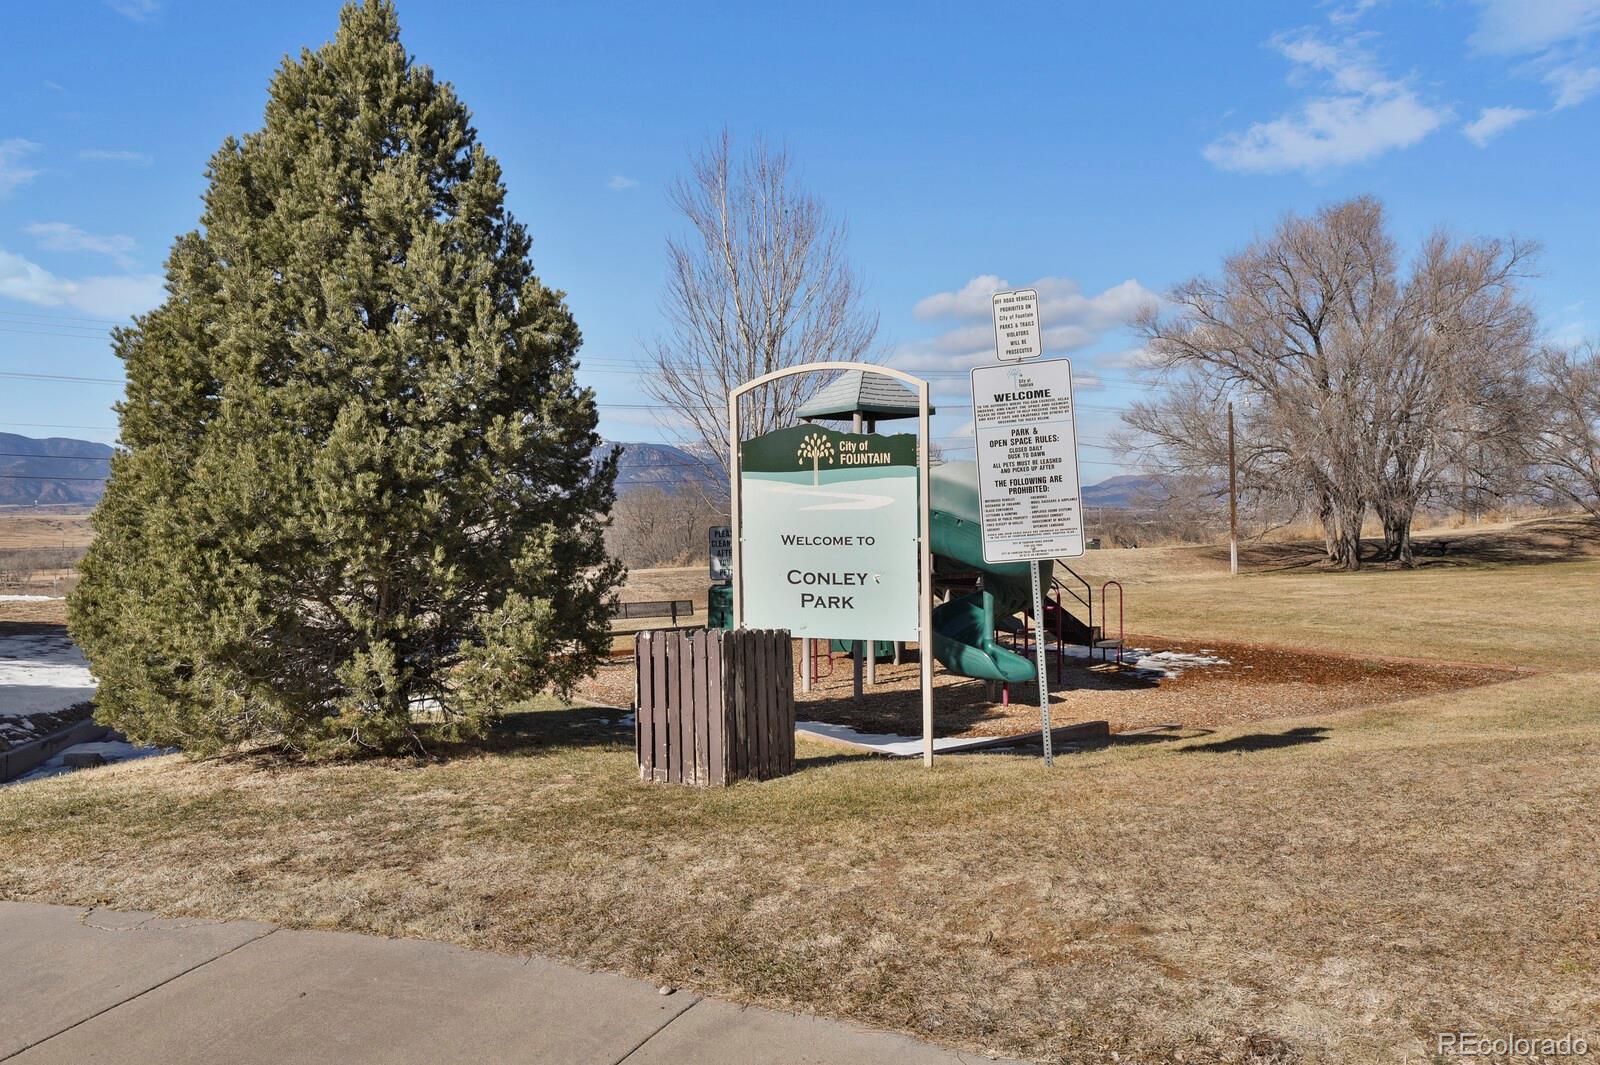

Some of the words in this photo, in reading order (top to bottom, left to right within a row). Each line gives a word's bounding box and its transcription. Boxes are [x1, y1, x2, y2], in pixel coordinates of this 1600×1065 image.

[994, 389, 1051, 402] WELCOME
[839, 440, 857, 453] City
[859, 440, 868, 451] of
[1010, 437, 1032, 446] SPACE
[1035, 434, 1059, 443] RULES:
[840, 452, 891, 465] FOUNTAIN
[1010, 476, 1046, 486] FOLLOWING
[1009, 485, 1049, 494] PROHIBITED:
[781, 535, 853, 546] WELCOME
[787, 570, 868, 585] CONLEY
[801, 593, 854, 609] PARK
